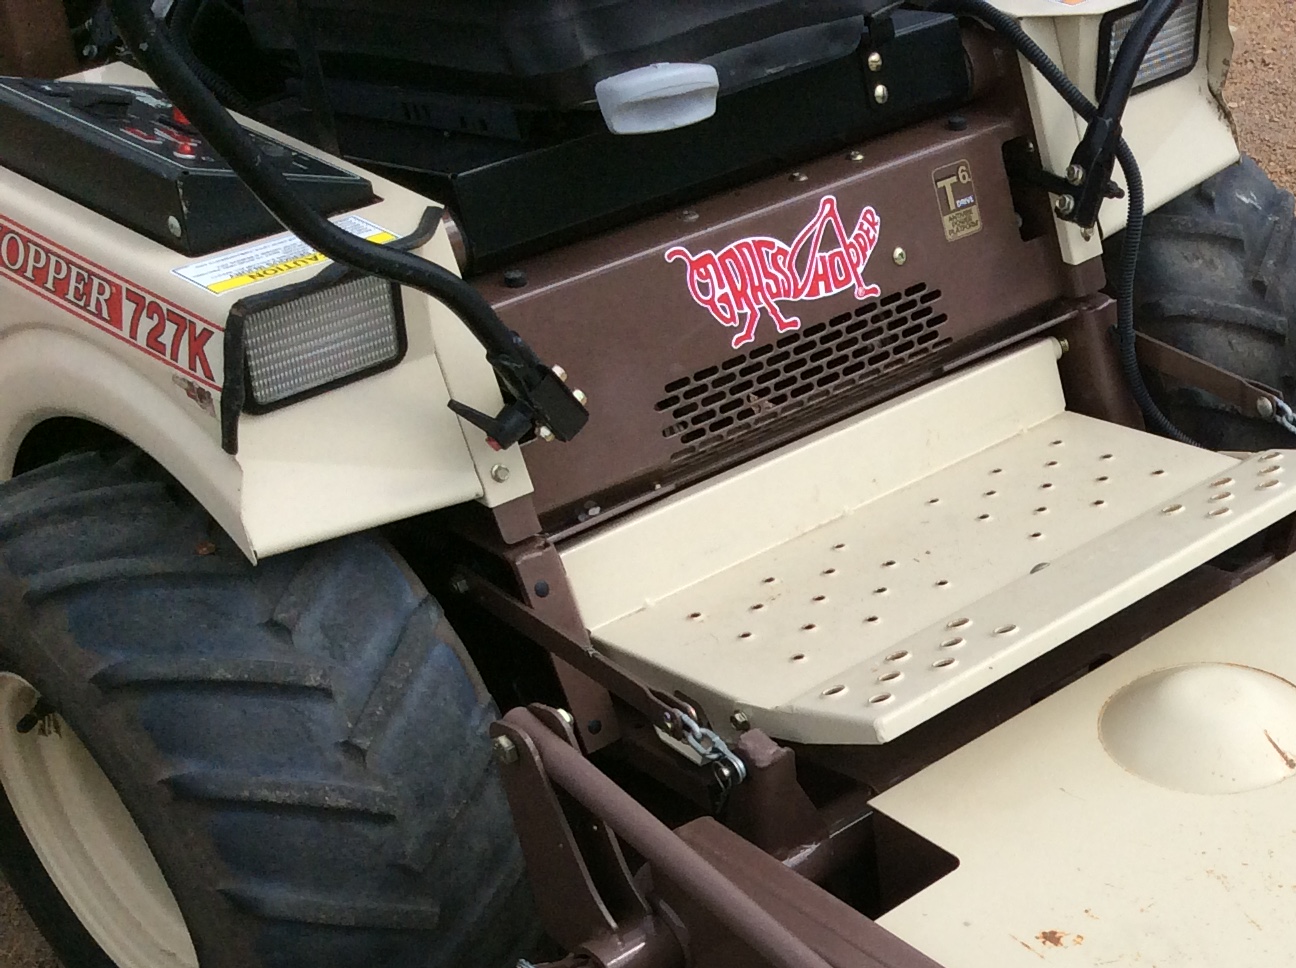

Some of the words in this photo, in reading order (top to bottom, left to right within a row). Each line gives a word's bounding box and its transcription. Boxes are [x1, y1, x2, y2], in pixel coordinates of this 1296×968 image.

[0, 231, 112, 321] OPPER
[125, 287, 215, 382] 727K
[248, 253, 321, 280] AUTION
[678, 198, 880, 336] GRASSHOPPER
